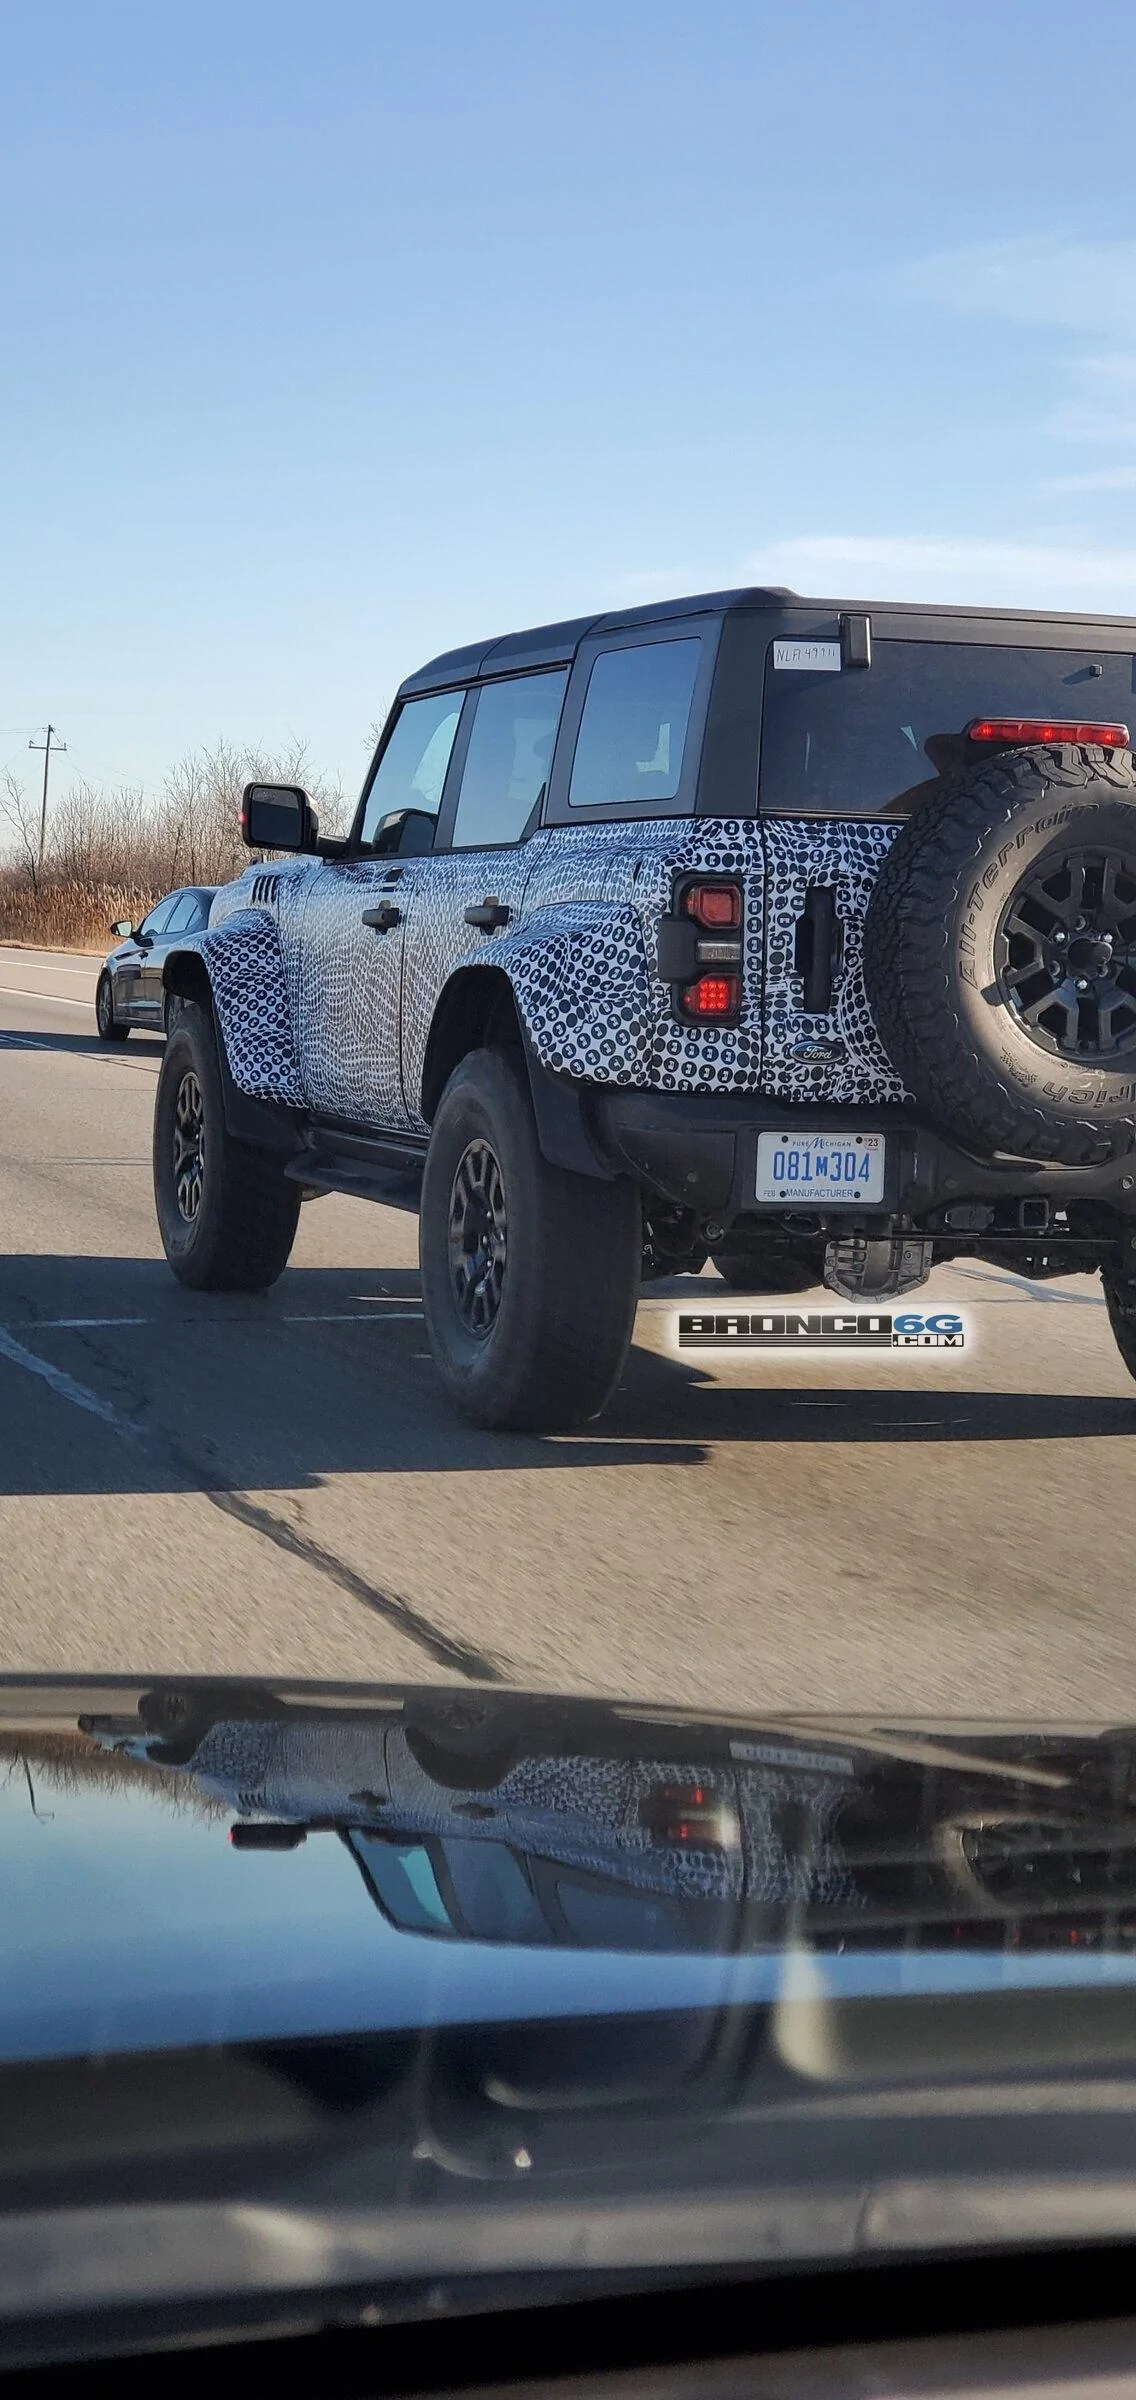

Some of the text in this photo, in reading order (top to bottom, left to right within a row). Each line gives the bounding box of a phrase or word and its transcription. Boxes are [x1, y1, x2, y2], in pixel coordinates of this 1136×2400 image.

[803, 1045, 832, 1059] Ford
[806, 1137, 851, 1150] MICHIGAN
[868, 1138, 879, 1147] 23
[773, 1151, 870, 1182] 081M304
[785, 1188, 854, 1198] MANUFACTURER
